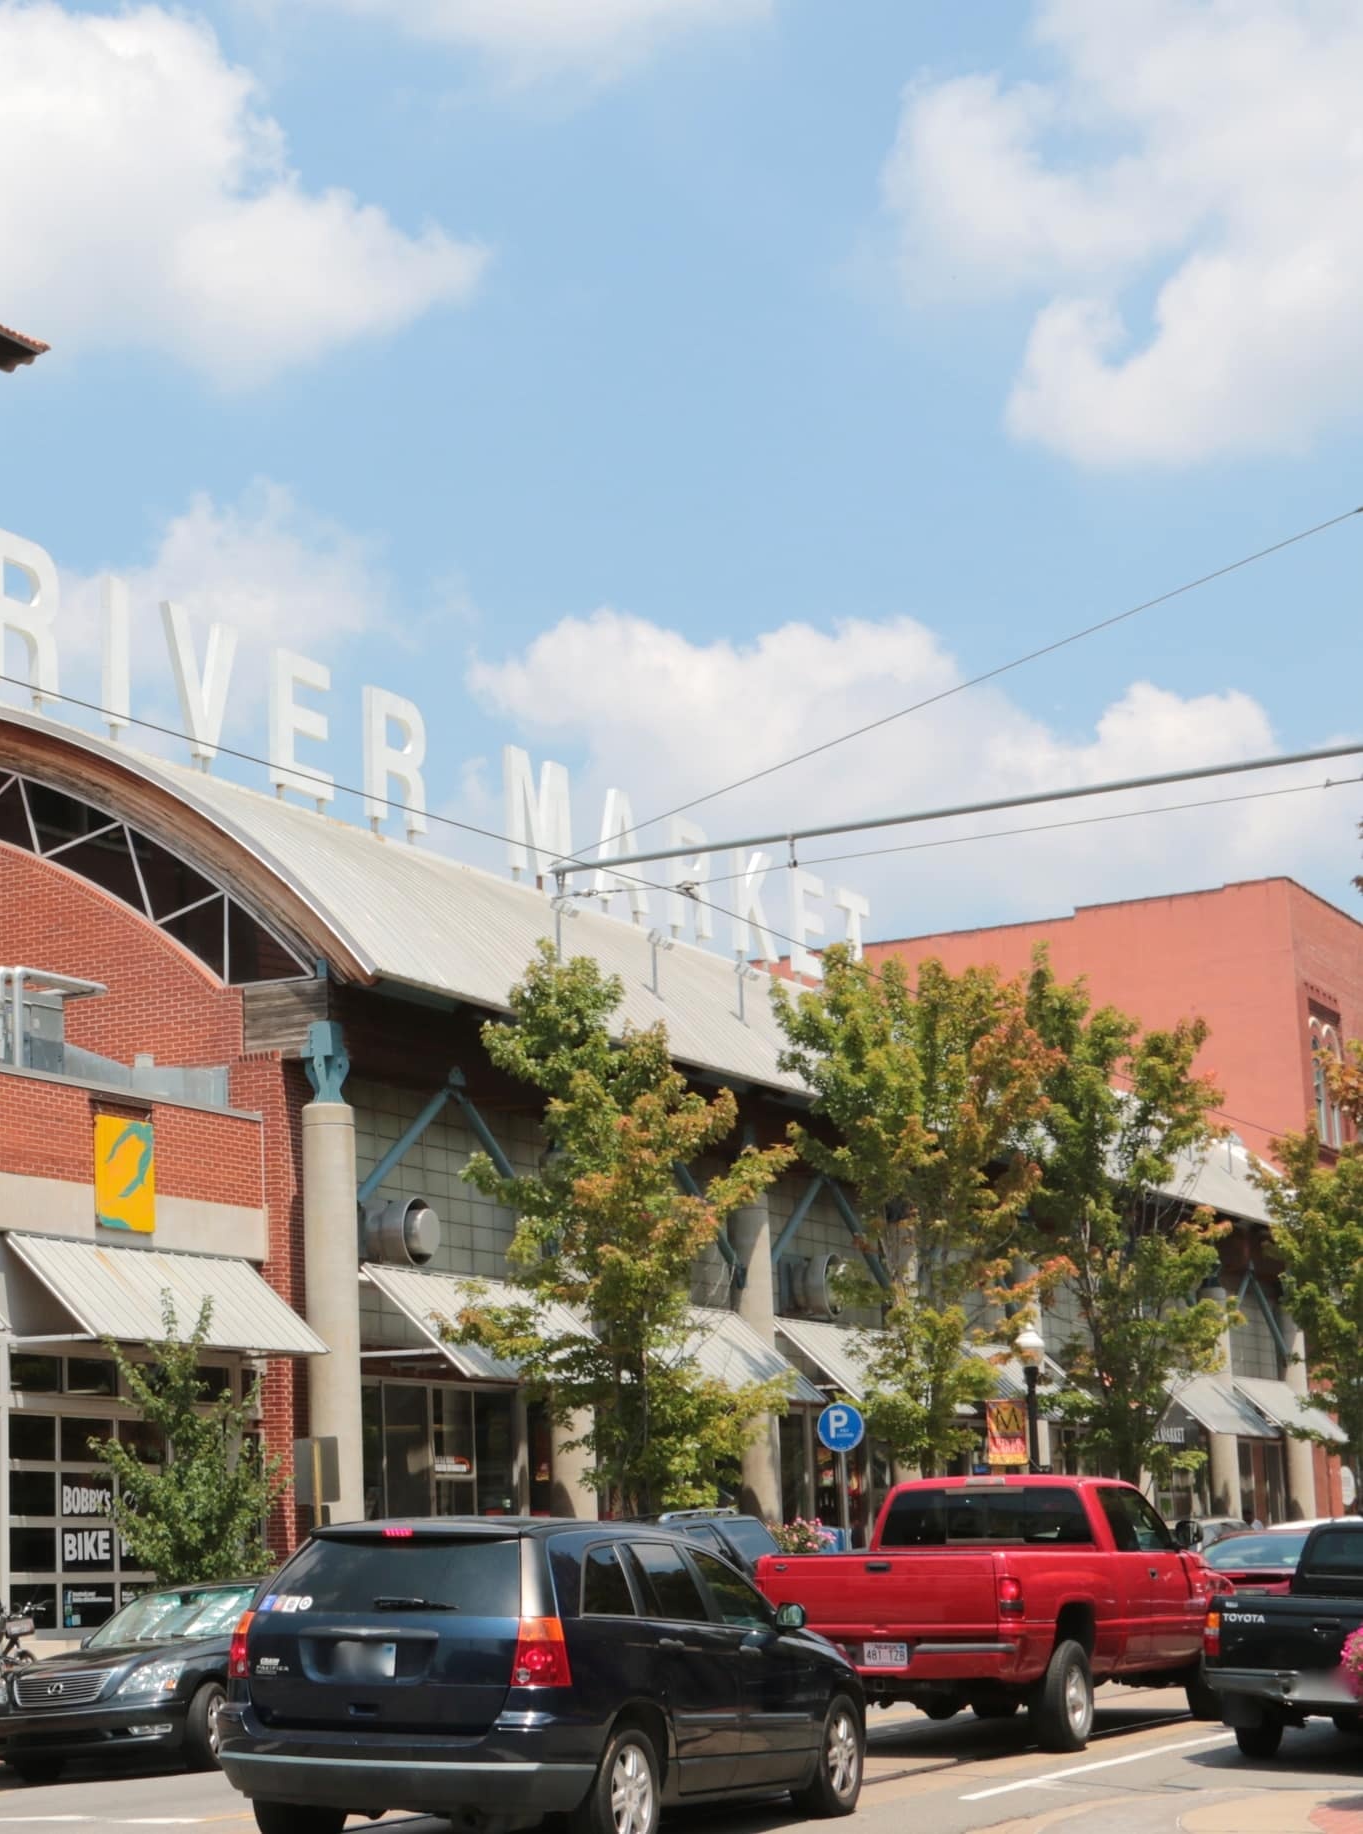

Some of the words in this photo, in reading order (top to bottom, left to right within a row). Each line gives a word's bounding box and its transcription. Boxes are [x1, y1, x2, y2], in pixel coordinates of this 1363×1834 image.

[504, 744, 869, 981] MARKET
[829, 1409, 848, 1439] P
[64, 1530, 111, 1561] BIKE
[1222, 1612, 1265, 1624] TOYOTA
